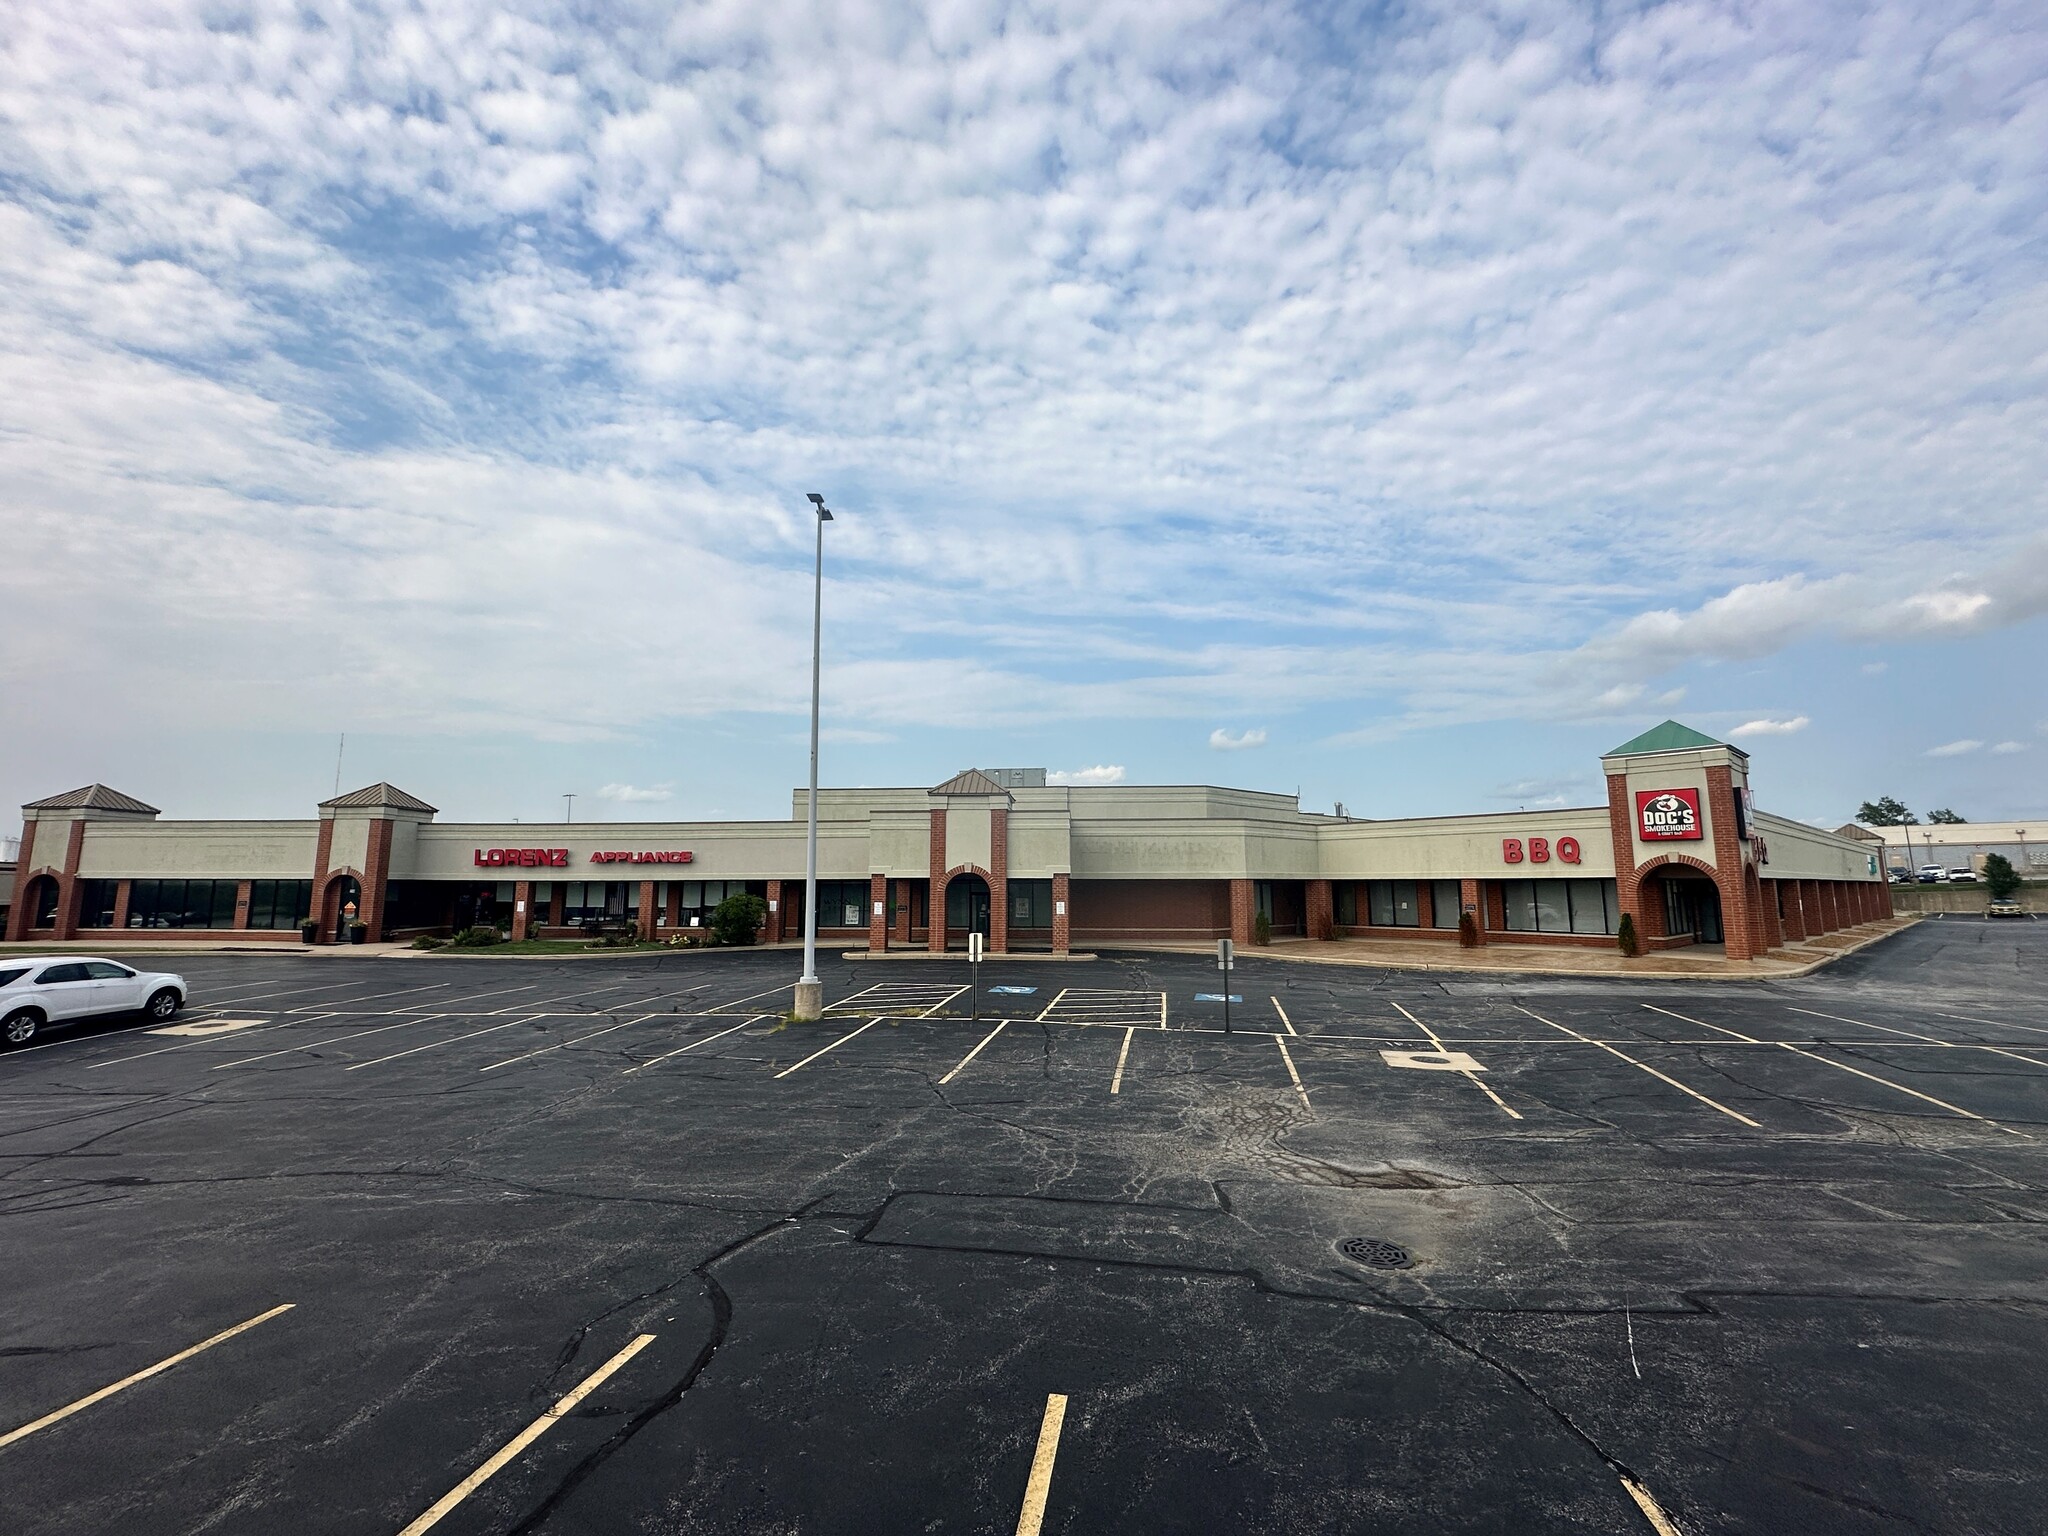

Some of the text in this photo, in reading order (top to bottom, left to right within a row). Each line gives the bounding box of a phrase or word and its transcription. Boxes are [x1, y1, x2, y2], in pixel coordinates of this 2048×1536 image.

[1643, 809, 1695, 825] DOC'S
[1644, 824, 1696, 833] SMOKEHOUSE
[474, 848, 694, 866] LORENZ APPLIANCE
[1503, 836, 1582, 865] BBQ
